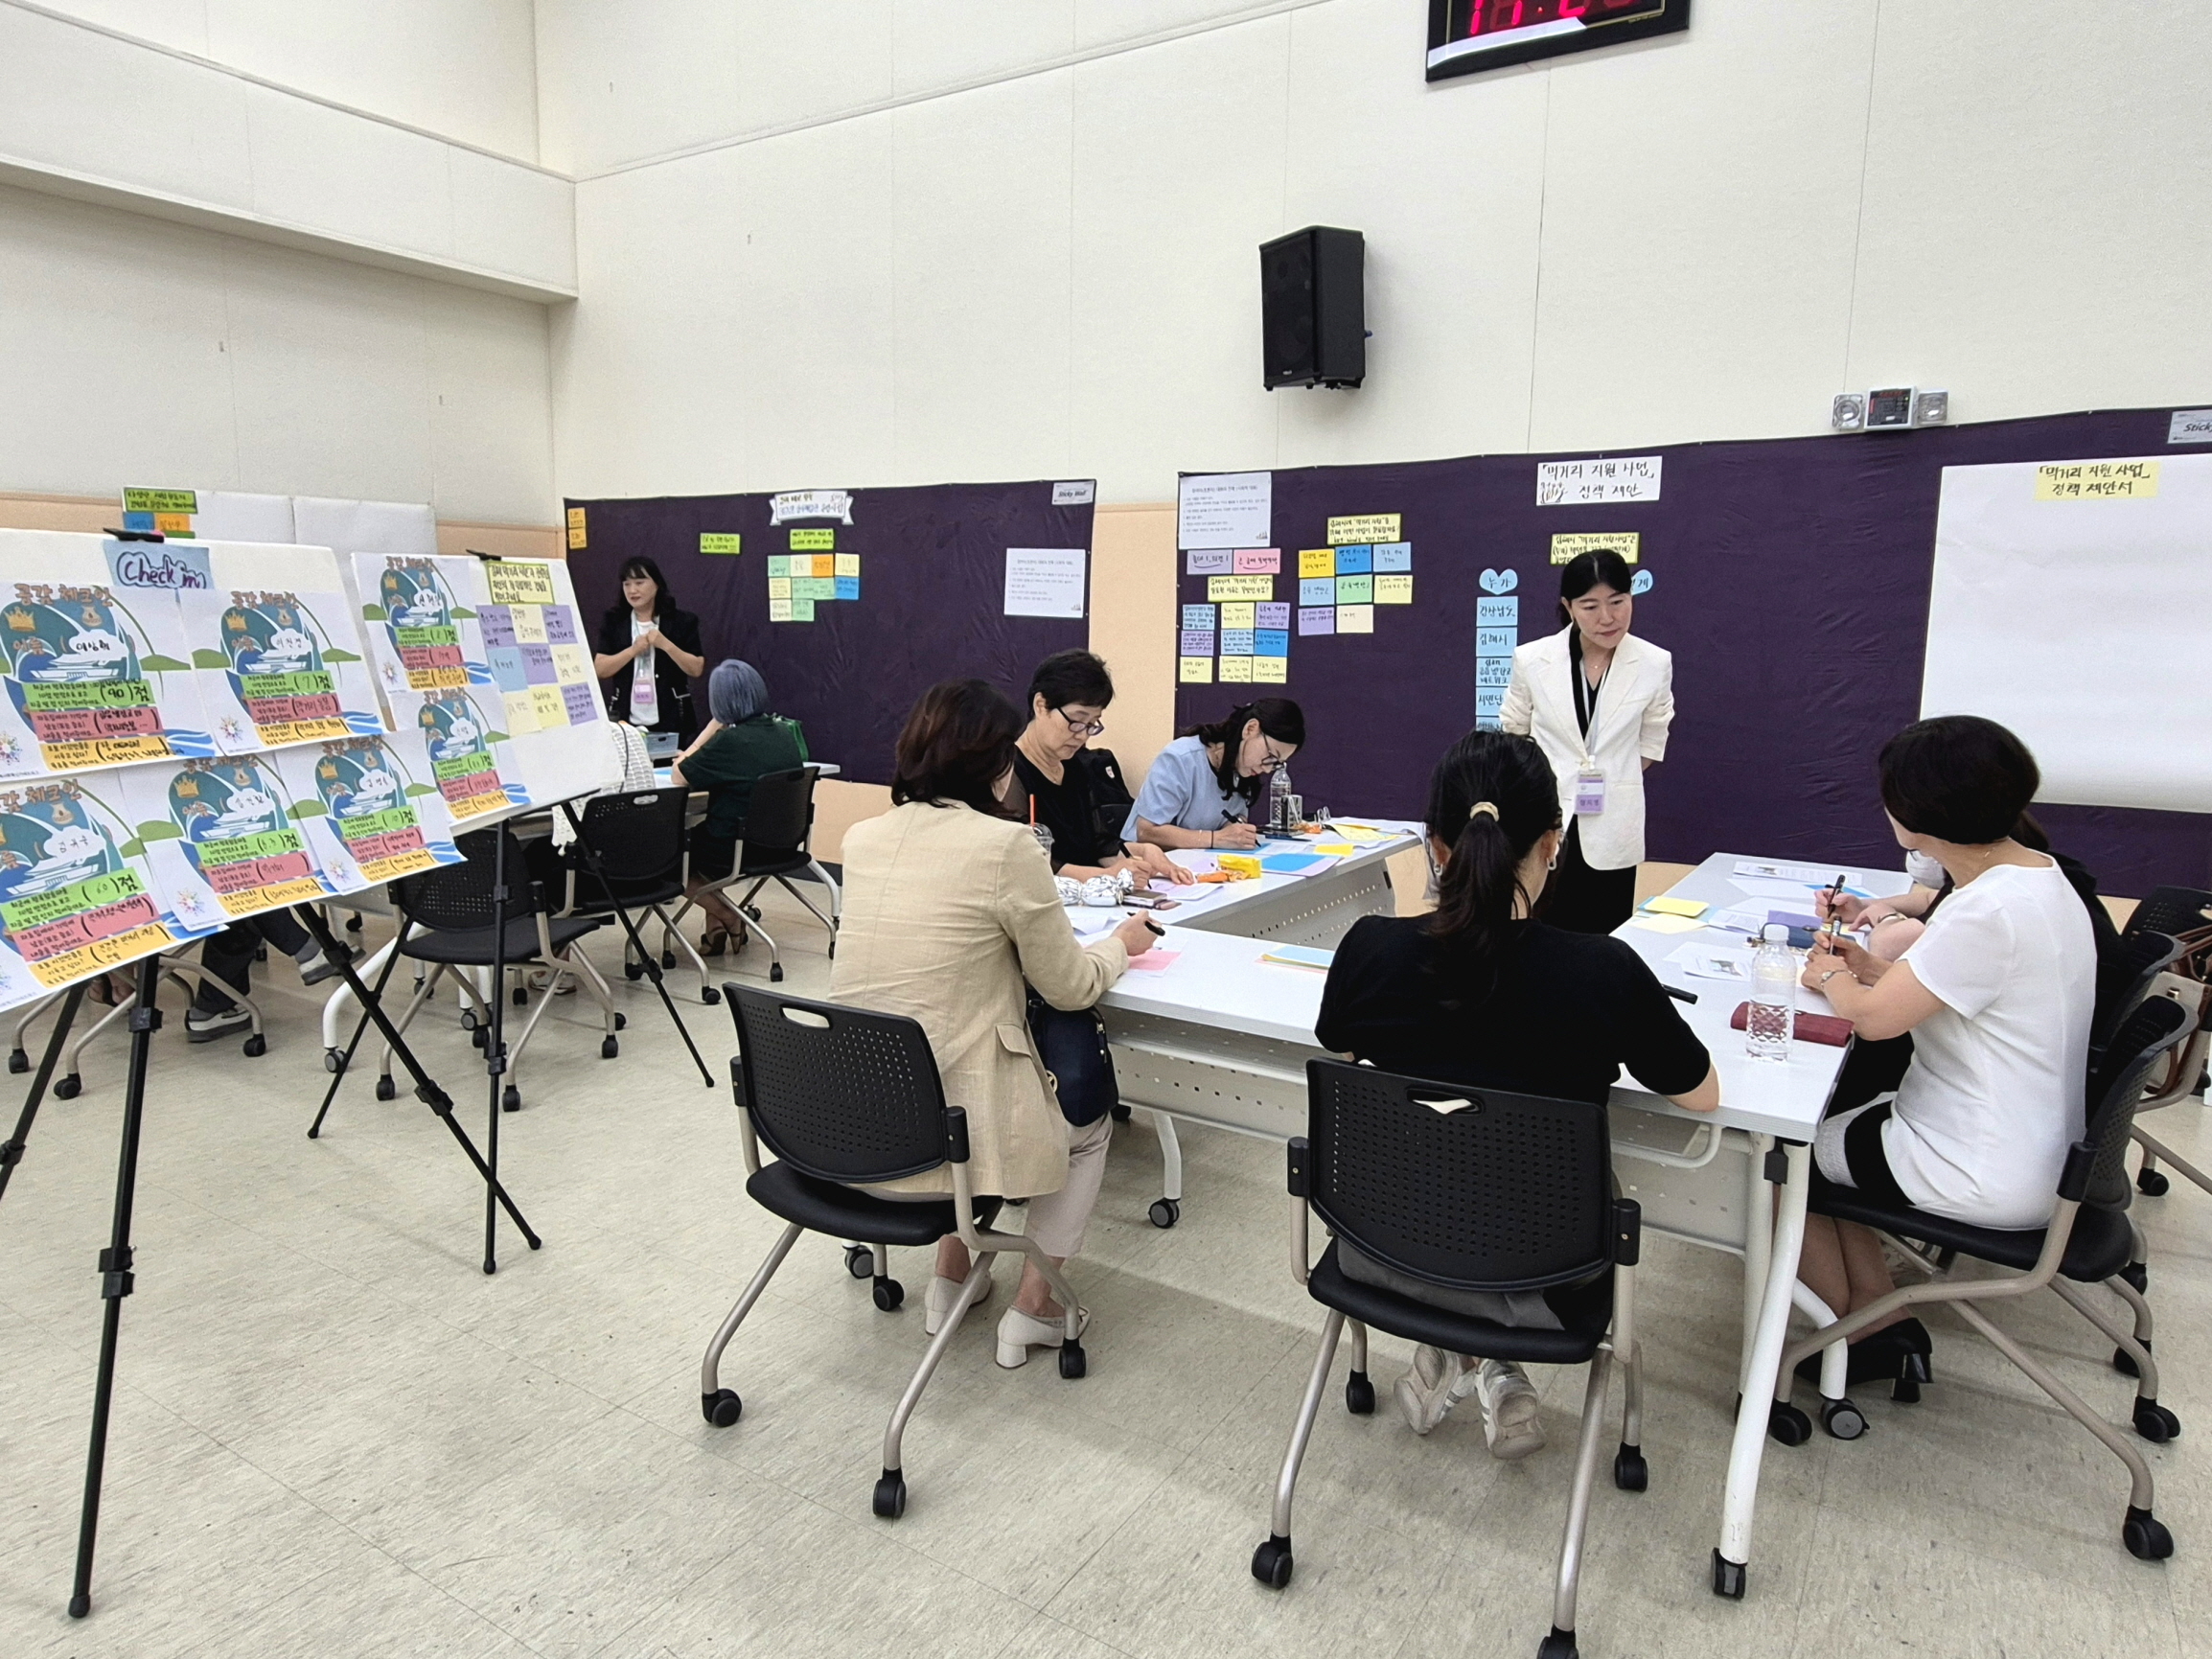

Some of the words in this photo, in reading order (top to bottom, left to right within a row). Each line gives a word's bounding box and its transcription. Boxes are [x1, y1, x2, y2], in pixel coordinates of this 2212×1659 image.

[1592, 463, 1616, 477] 지원
[2088, 464, 2112, 478] 지원
[1579, 484, 1604, 499] 정책
[1612, 483, 1644, 497] 제안
[2053, 482, 2081, 496] 정책
[2085, 481, 2133, 495] 제안서
[125, 558, 176, 585] Check
[1488, 577, 1510, 588] 누가
[13, 583, 53, 606] 공감
[58, 584, 113, 607] 체크인
[231, 590, 258, 610] 공감
[260, 590, 299, 609] 체크인
[13, 636, 45, 655] 이름
[1480, 633, 1507, 646] 김해시
[1478, 694, 1503, 706] 시민단
[0, 790, 21, 814] 감
[26, 778, 81, 804] 체크인
